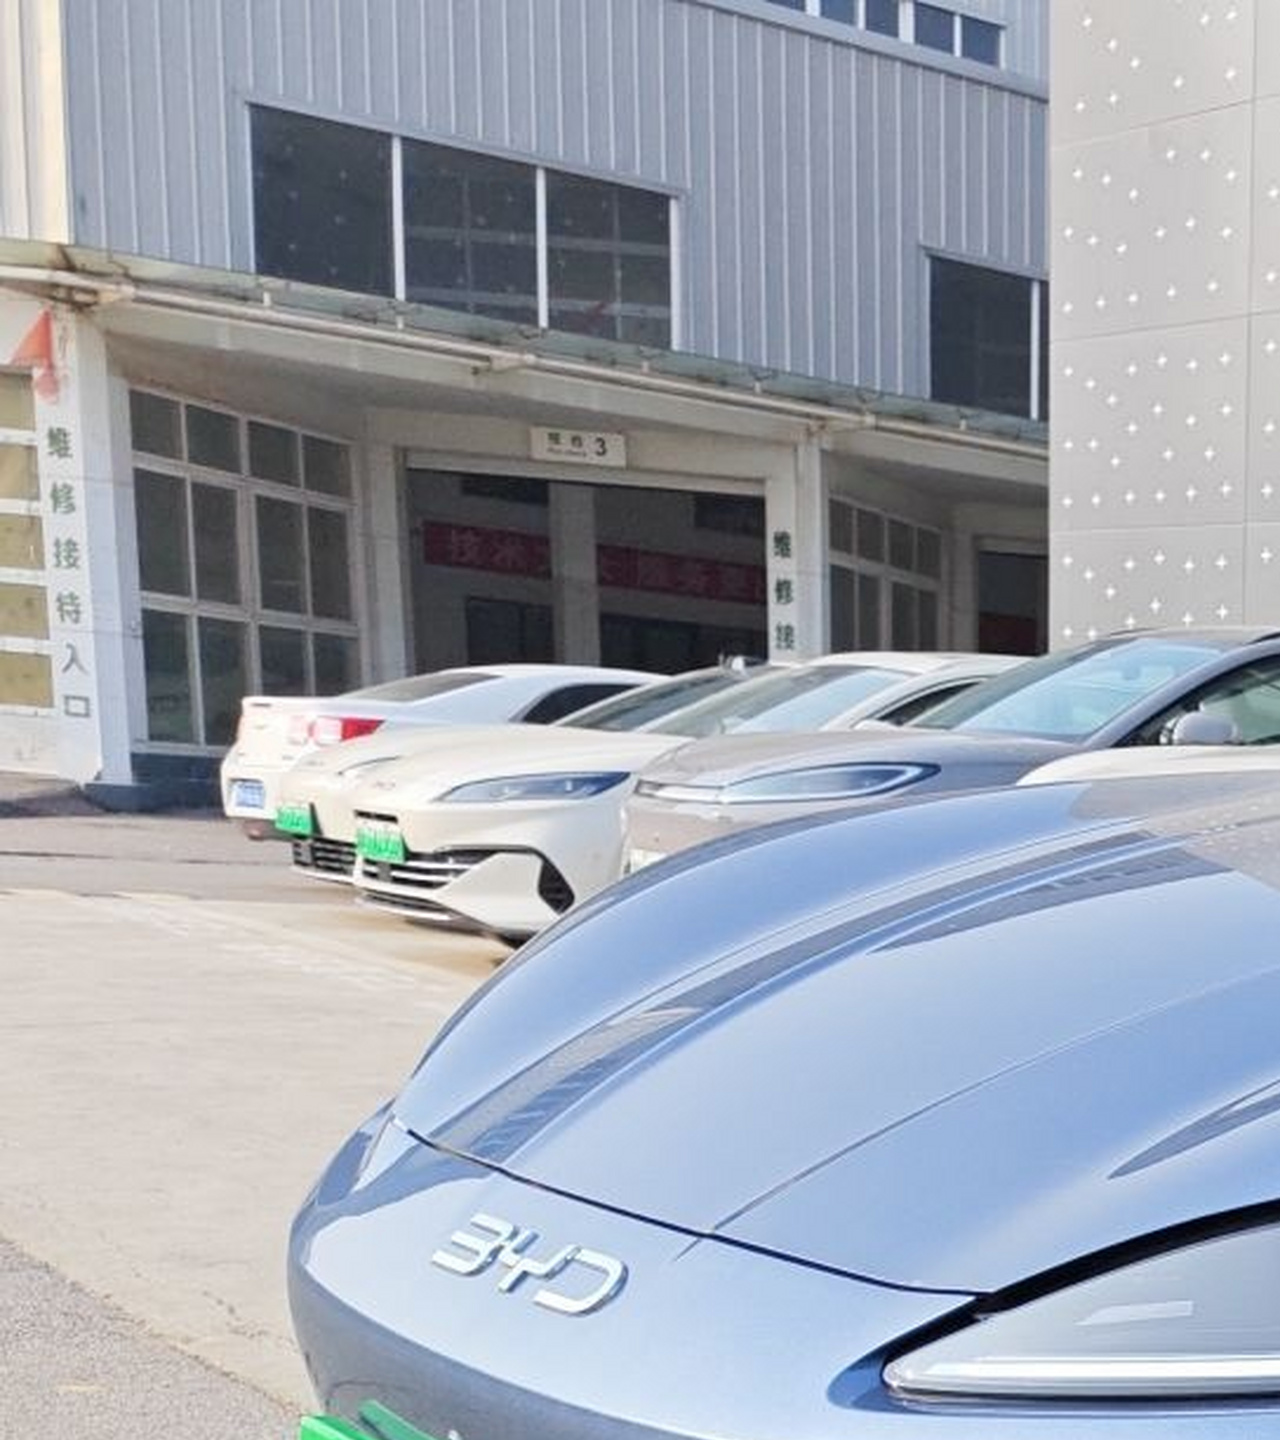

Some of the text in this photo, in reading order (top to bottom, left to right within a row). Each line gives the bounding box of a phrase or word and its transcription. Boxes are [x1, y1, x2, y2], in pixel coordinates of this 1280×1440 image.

[595, 437, 607, 456] 3
[46, 426, 92, 718] 维修接待入口
[432, 1213, 629, 1316] BYD
